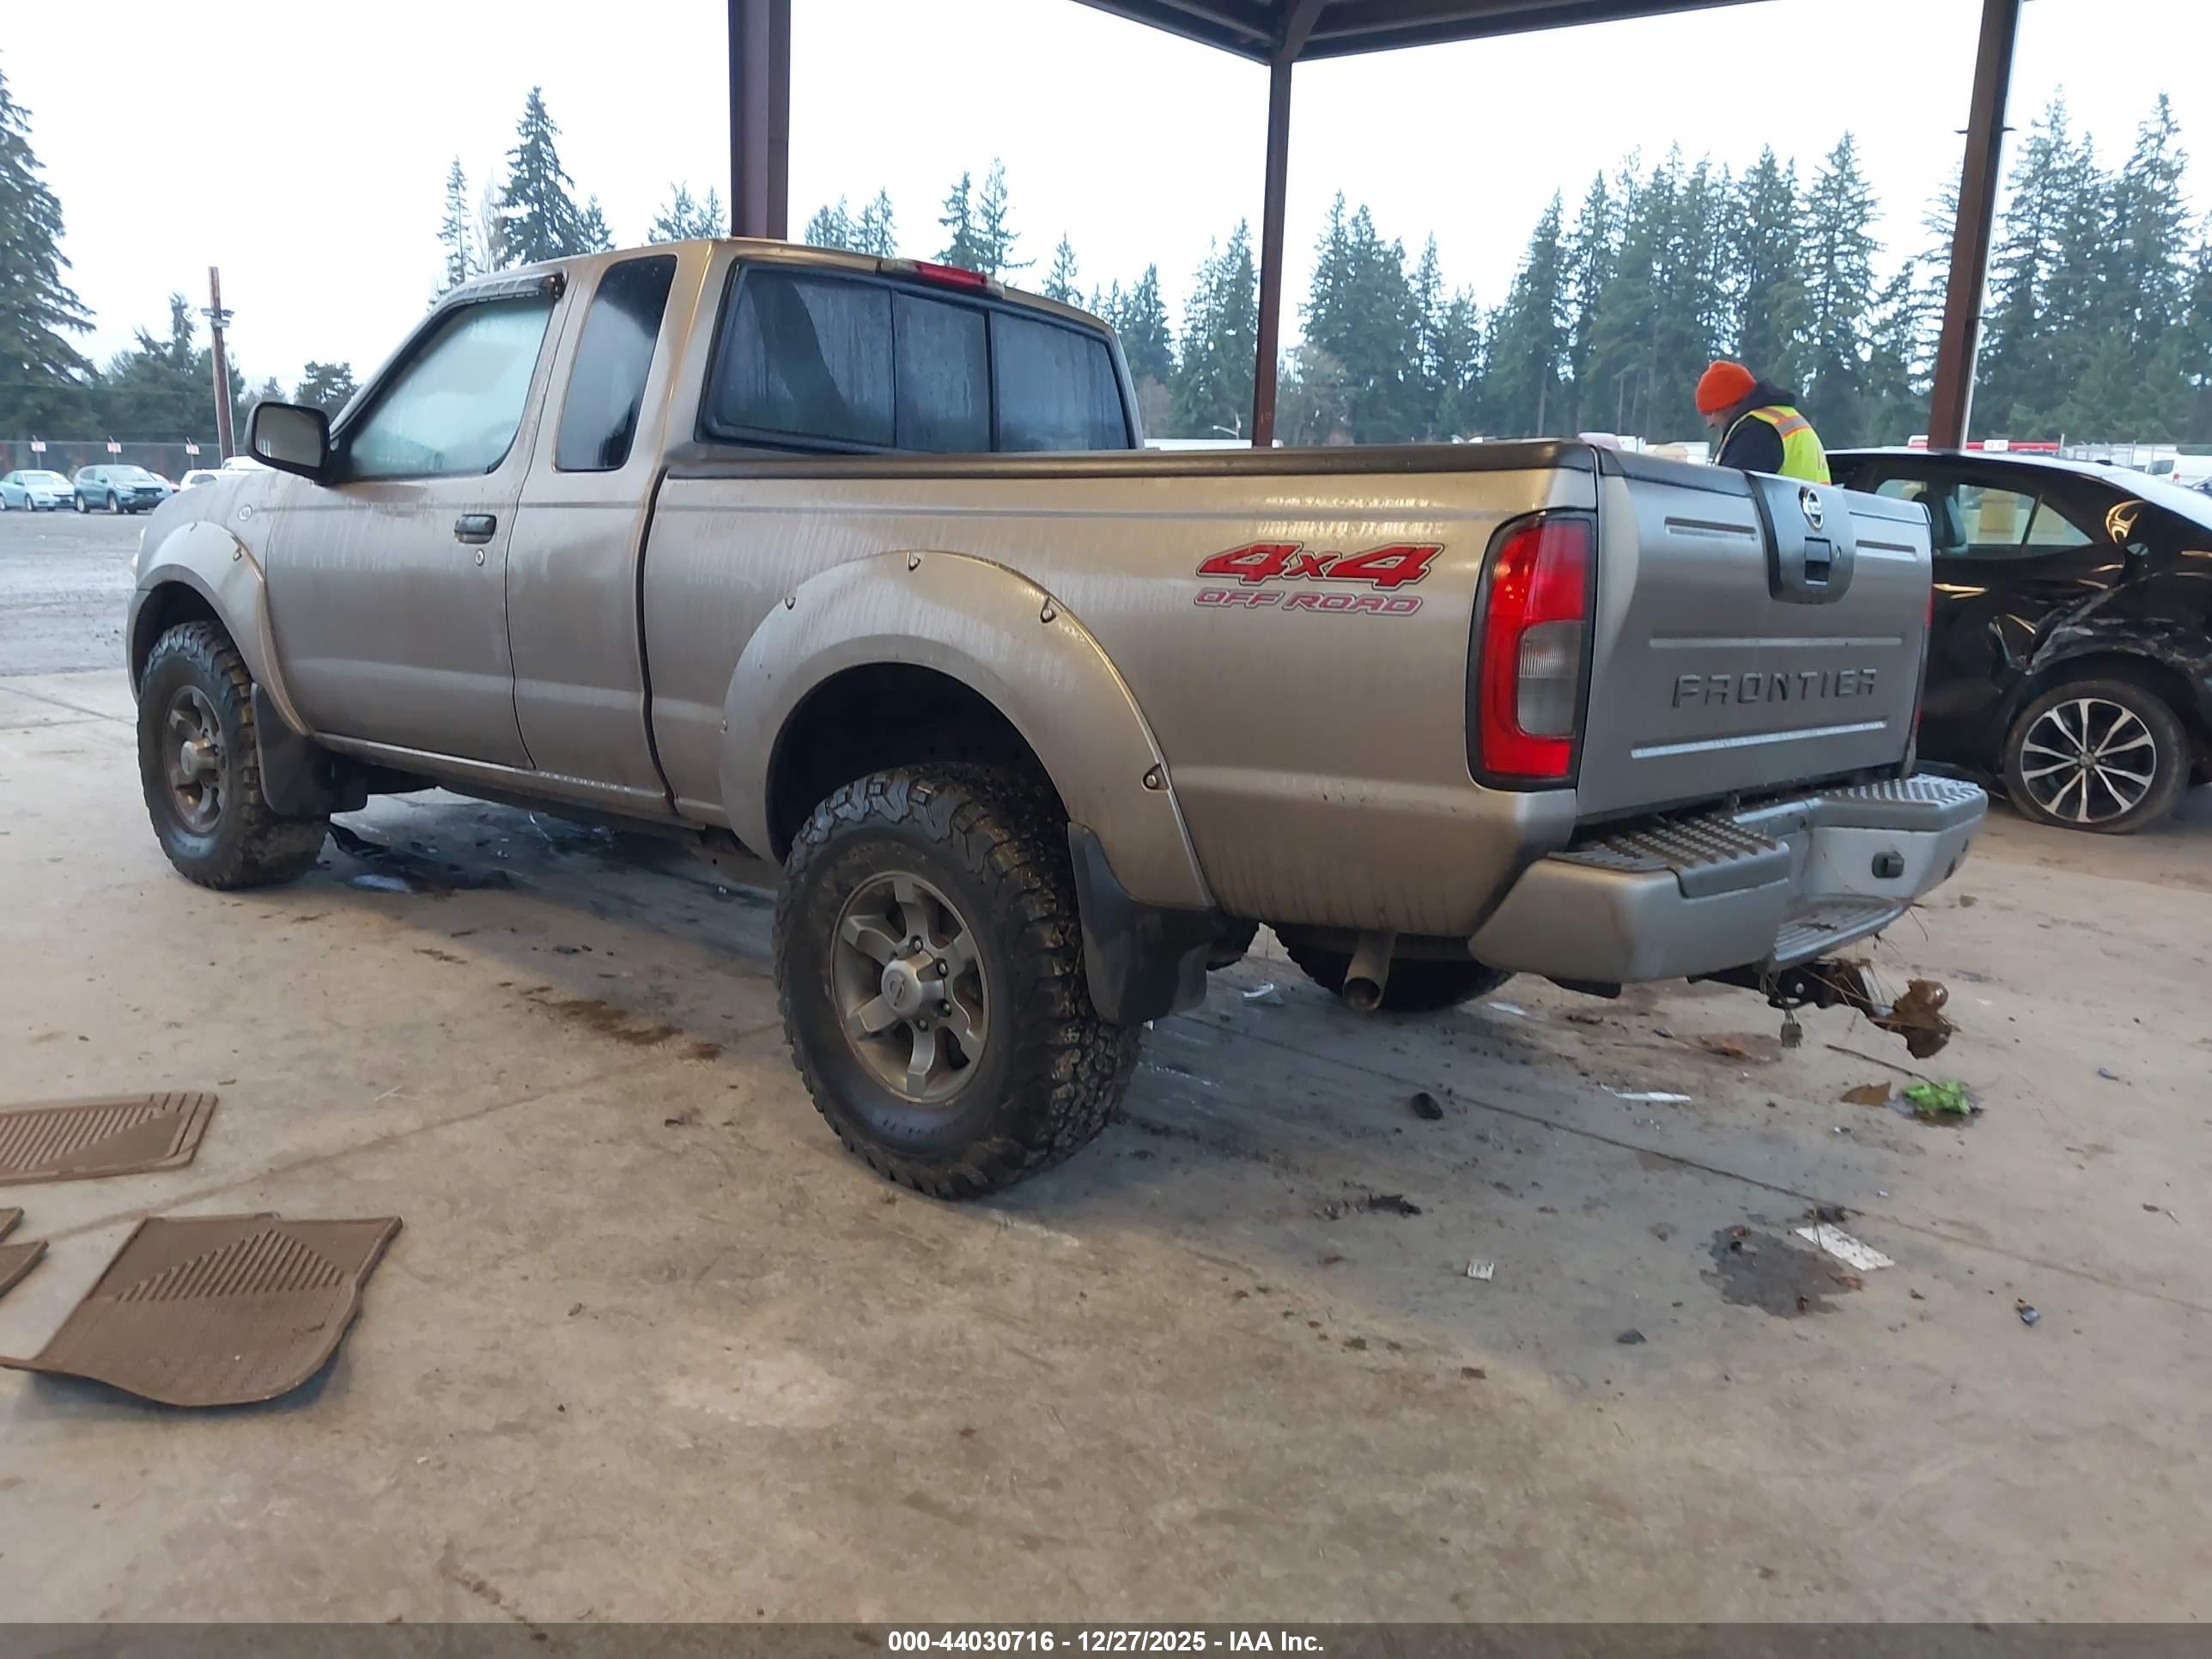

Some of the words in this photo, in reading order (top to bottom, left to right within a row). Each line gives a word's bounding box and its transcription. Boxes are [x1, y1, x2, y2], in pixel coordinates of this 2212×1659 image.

[1196, 541, 1444, 591] 4x4
[1194, 588, 1285, 609] OFF
[1283, 591, 1422, 617] ROAD
[1672, 667, 1878, 709] FRONTIER
